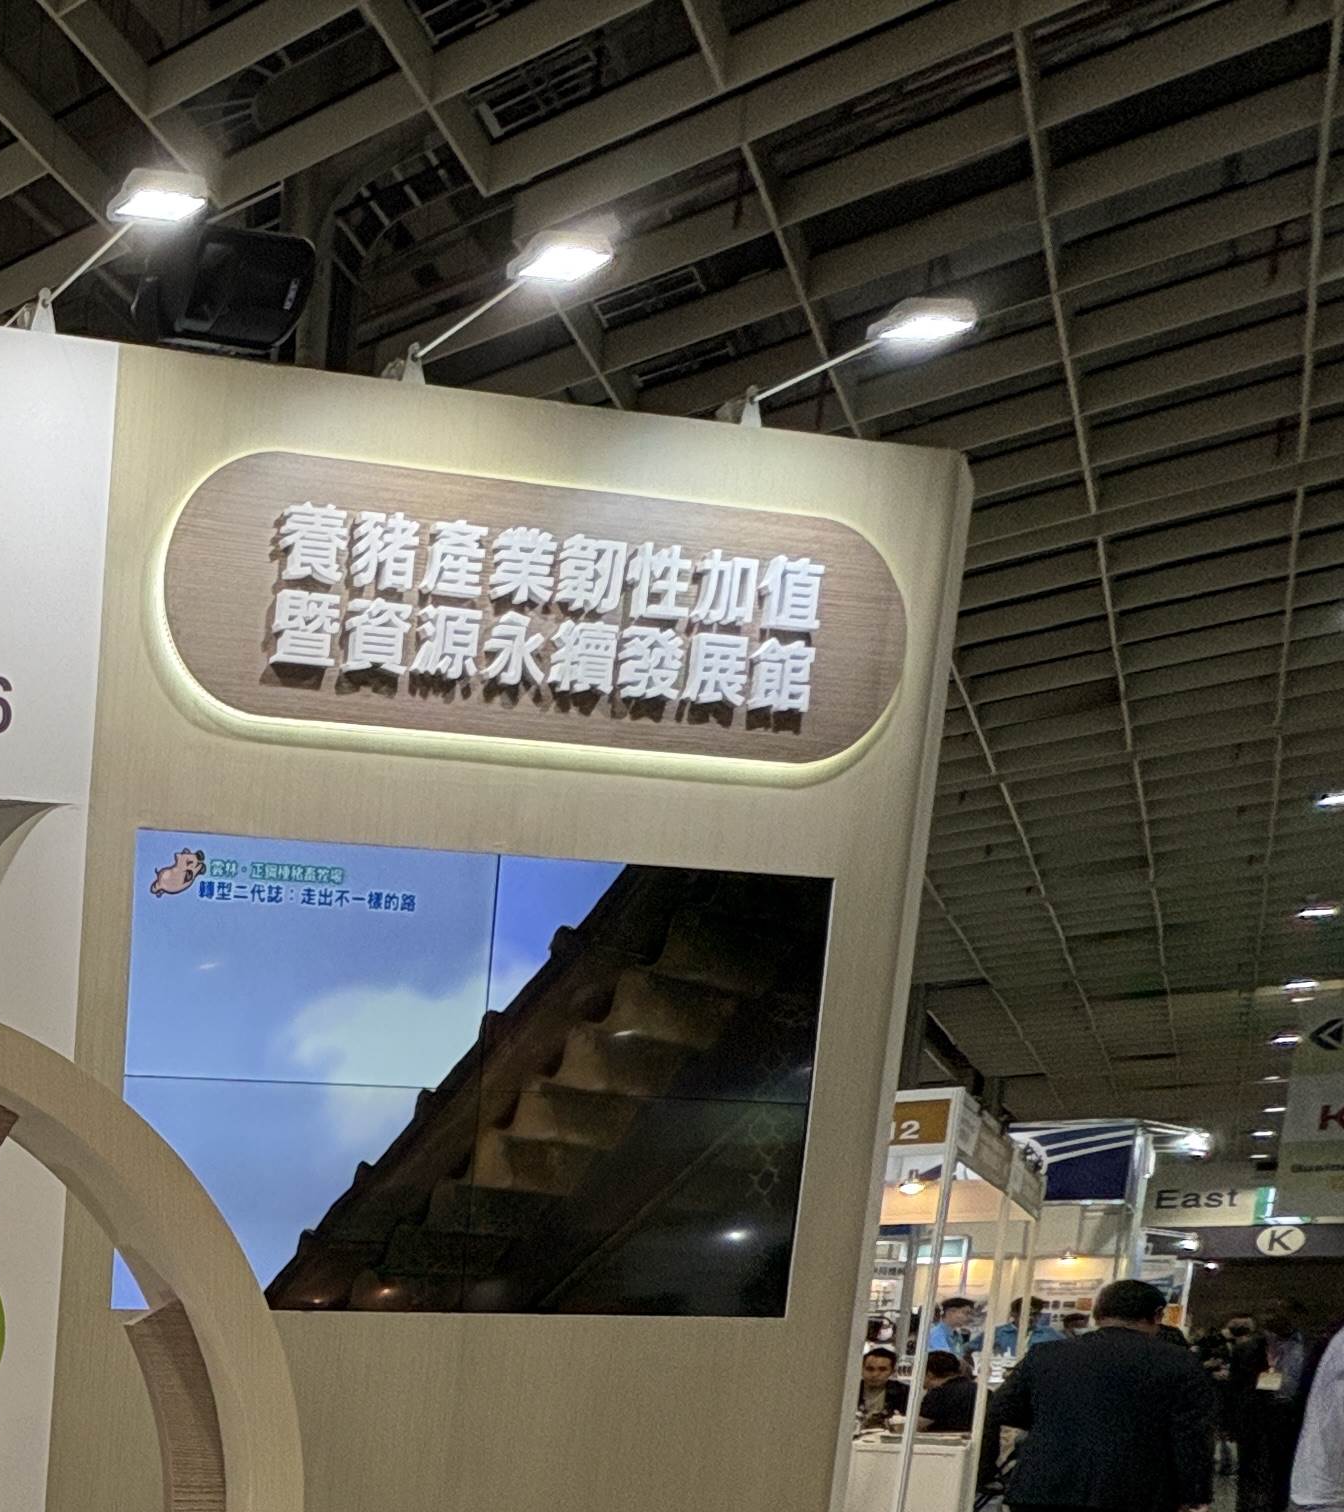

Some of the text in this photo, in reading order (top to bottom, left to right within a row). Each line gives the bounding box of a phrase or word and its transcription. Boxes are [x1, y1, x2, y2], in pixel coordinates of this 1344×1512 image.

[277, 501, 825, 631] 養豬產業韌性加值
[269, 589, 817, 714] 暨資源永續發展館
[1155, 1188, 1239, 1210] East
[1268, 1229, 1295, 1251] K
